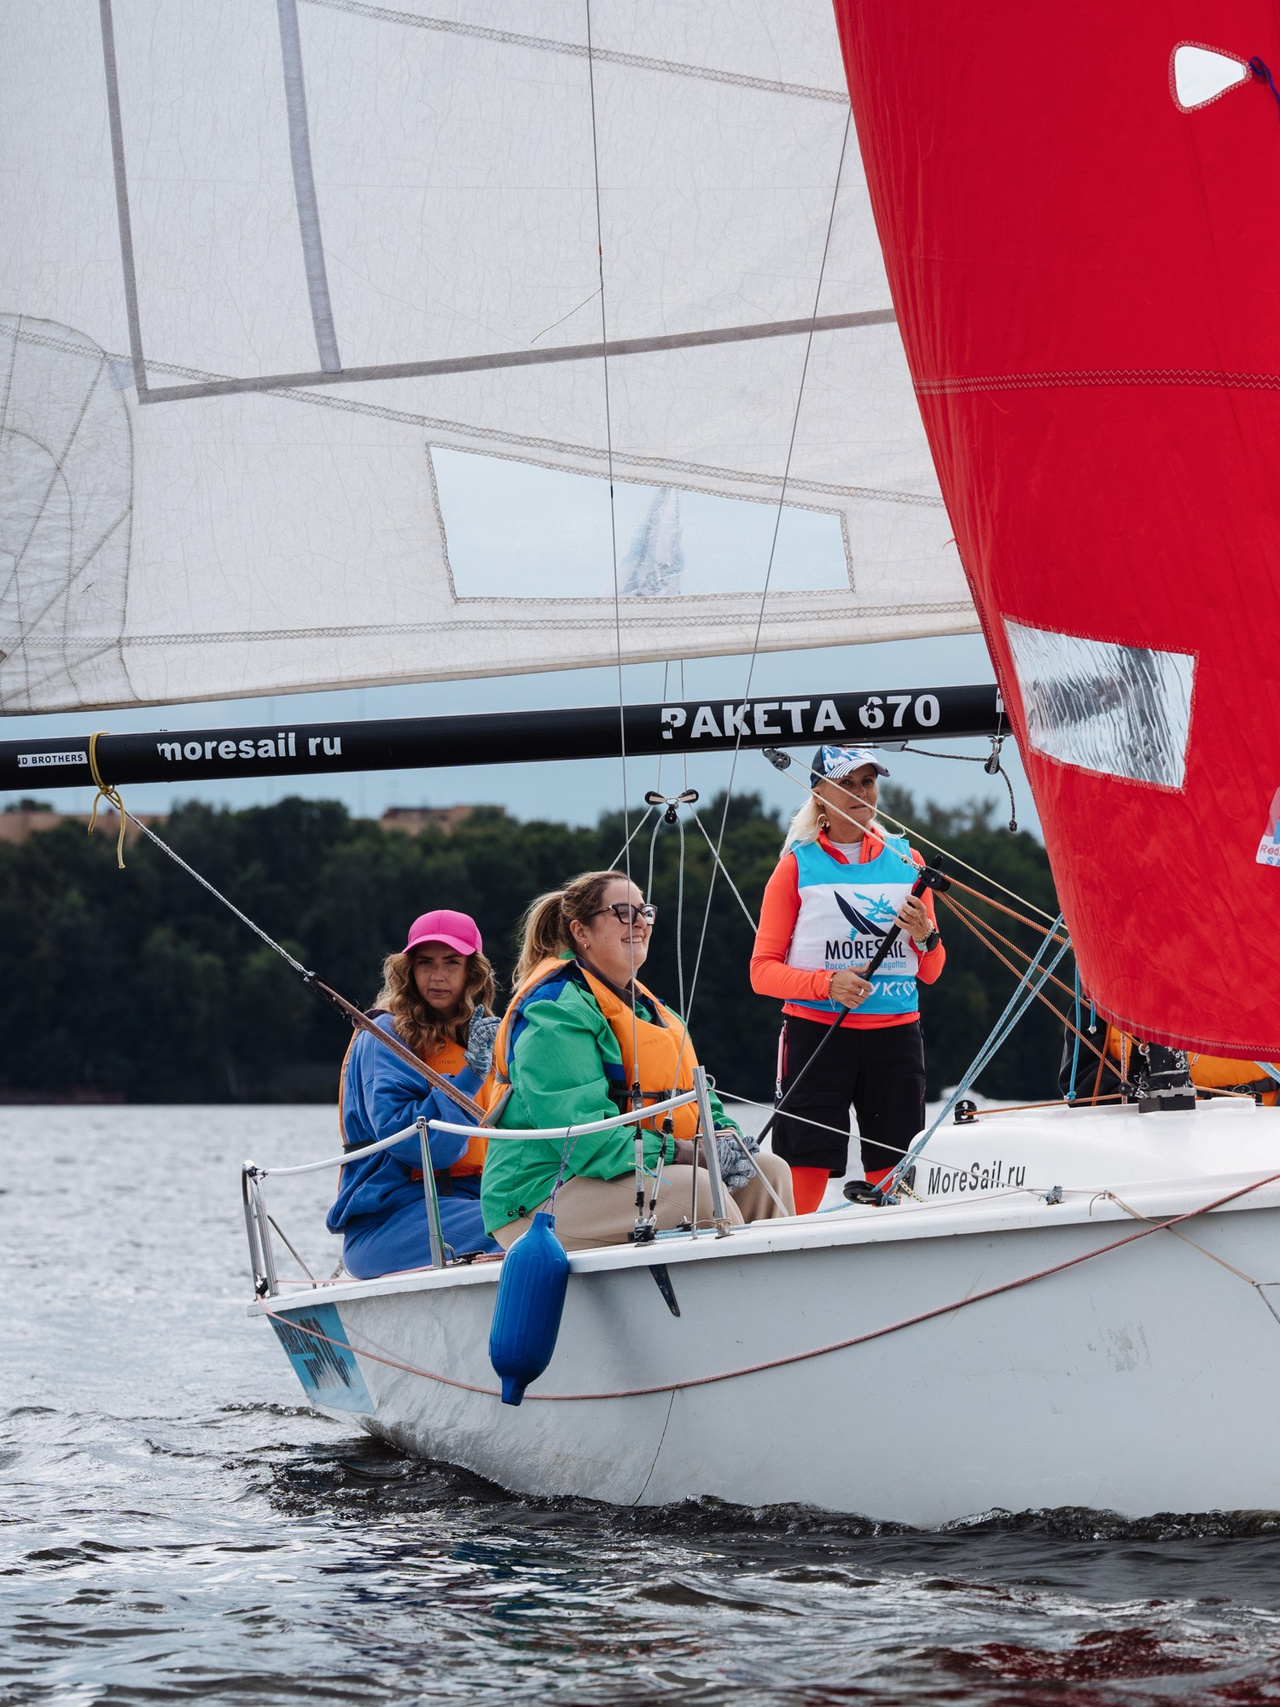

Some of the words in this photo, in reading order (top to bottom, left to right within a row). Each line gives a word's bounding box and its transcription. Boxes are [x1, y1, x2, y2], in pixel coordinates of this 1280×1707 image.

[858, 694, 941, 729] 670
[31, 753, 84, 764] BROTHERS
[157, 732, 297, 761] moresail
[308, 736, 342, 756] ru
